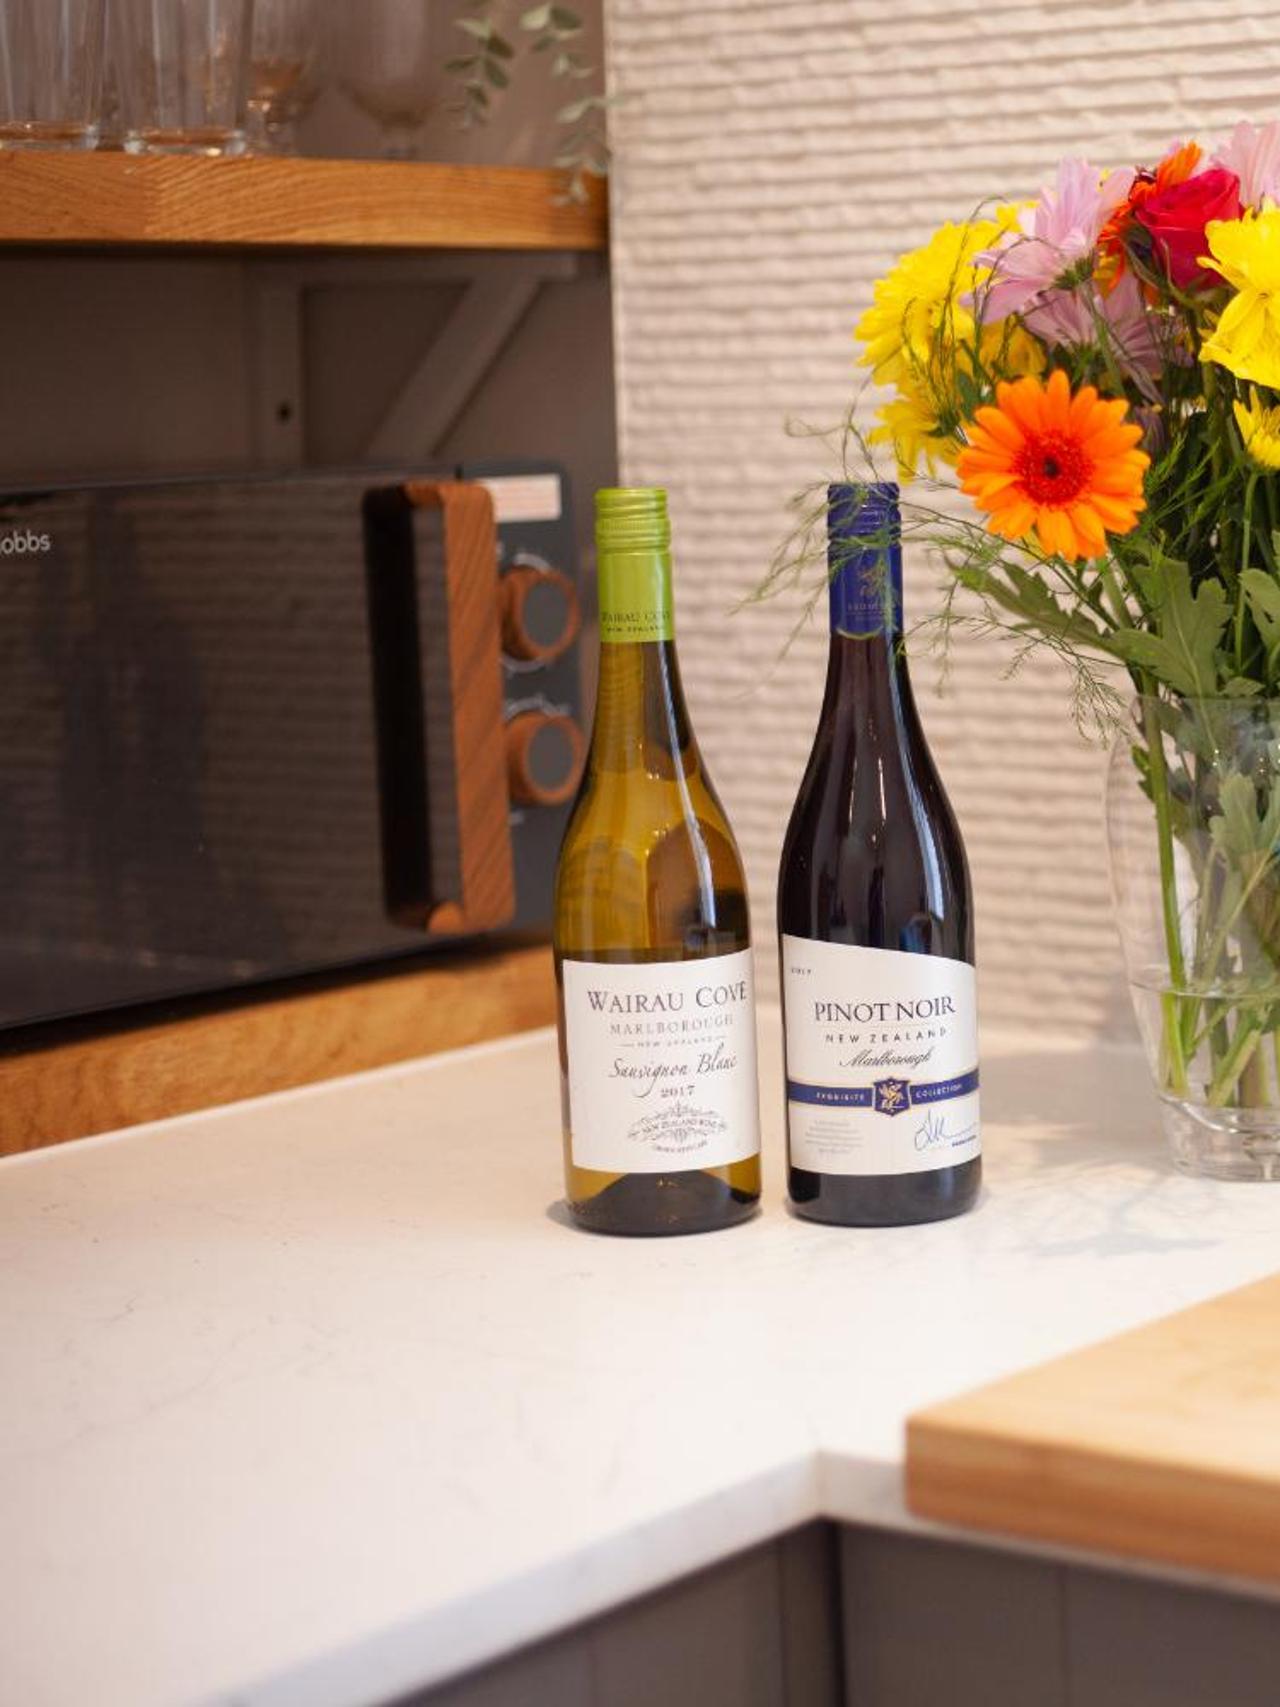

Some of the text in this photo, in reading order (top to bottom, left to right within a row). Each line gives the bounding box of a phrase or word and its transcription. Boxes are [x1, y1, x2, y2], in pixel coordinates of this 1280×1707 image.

[587, 980, 747, 1014] WAIRAU COVE
[813, 995, 957, 1023] PINOT NOIR
[609, 1013, 735, 1036] MARLBOROUGH
[826, 1026, 948, 1045] NEW ZEALAND
[838, 1046, 936, 1069] Marlborough
[608, 1042, 739, 1098] Sauvignon Blanc
[660, 1085, 696, 1099] 2017
[915, 1083, 963, 1099] COLLECTION
